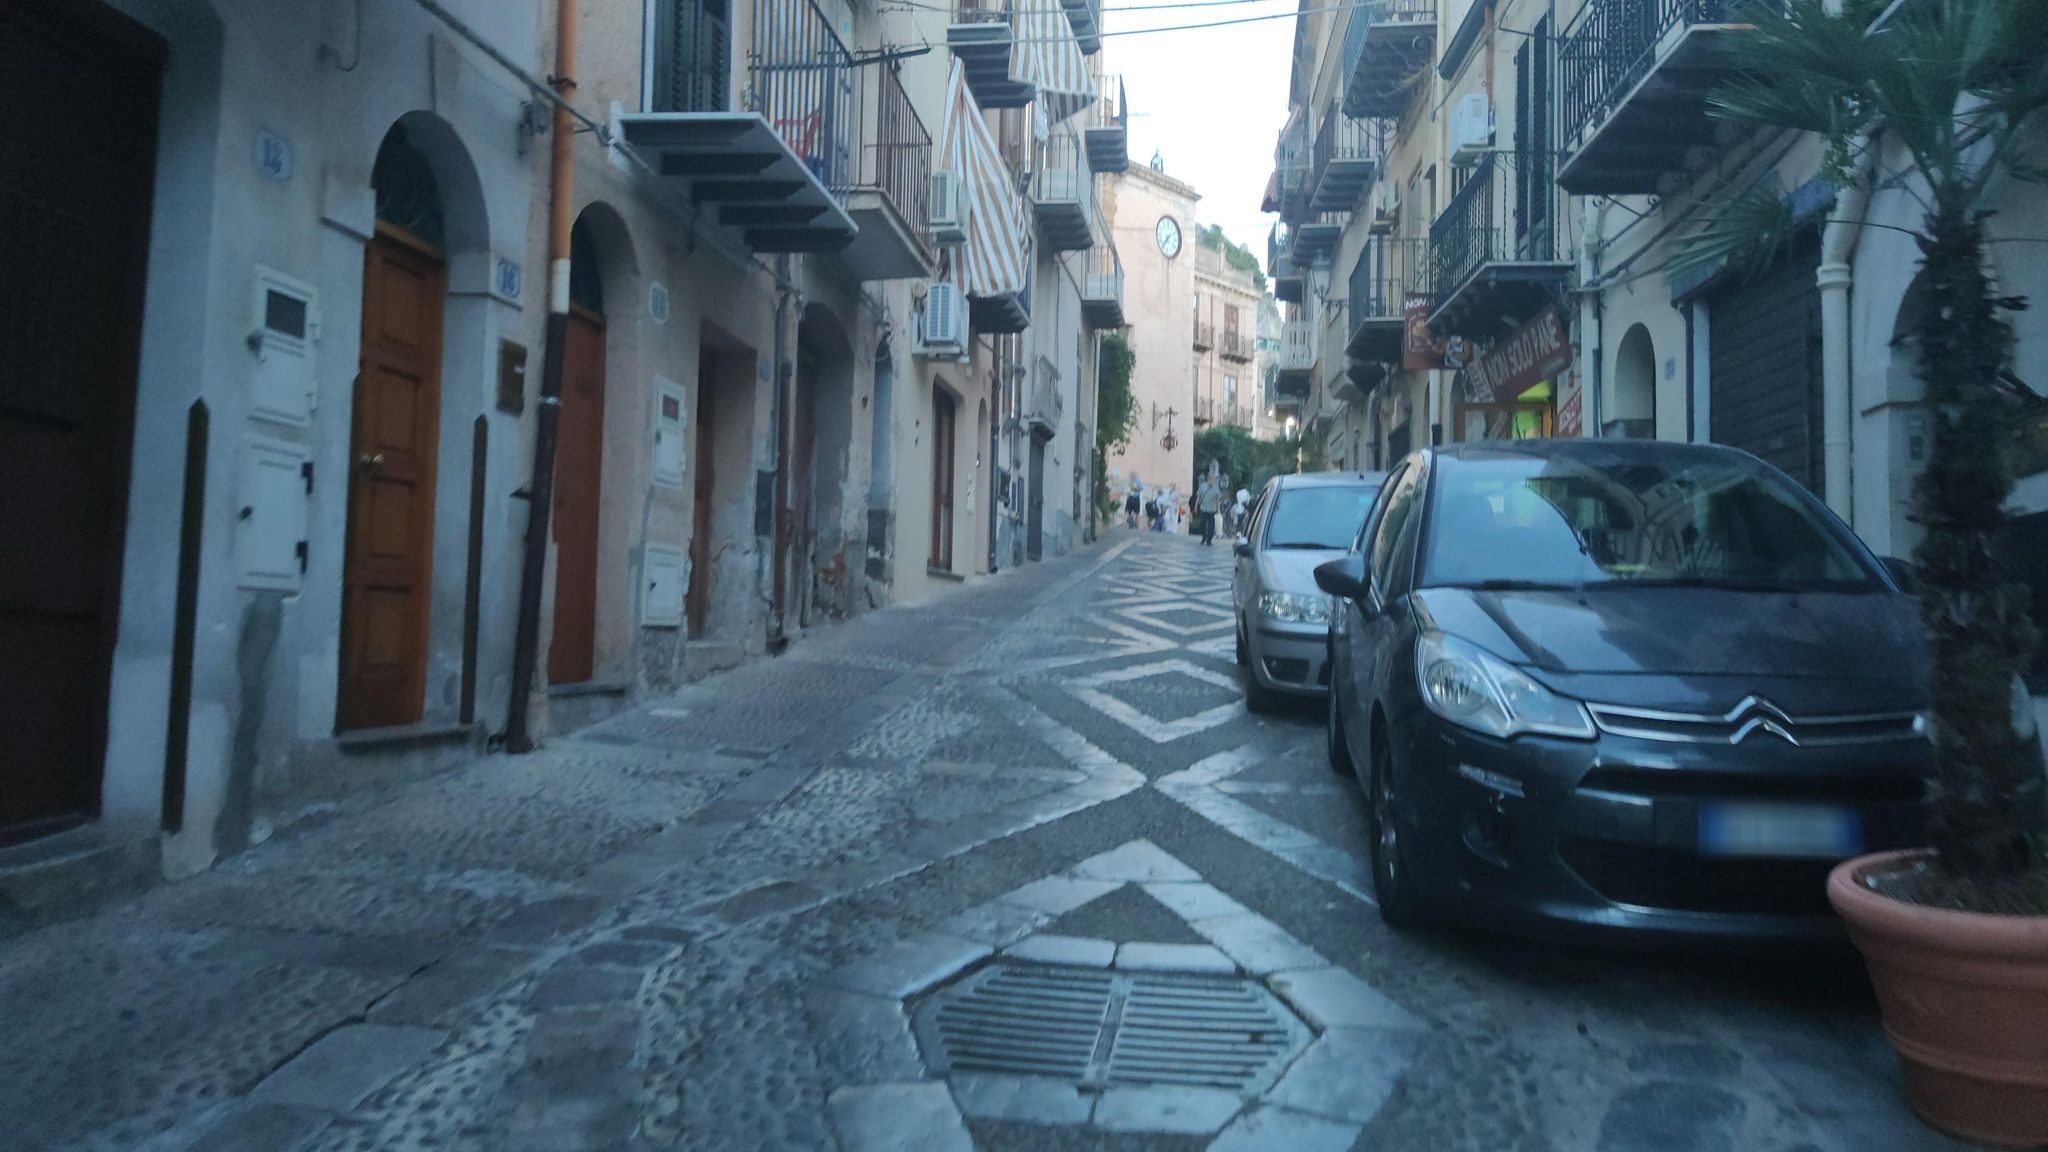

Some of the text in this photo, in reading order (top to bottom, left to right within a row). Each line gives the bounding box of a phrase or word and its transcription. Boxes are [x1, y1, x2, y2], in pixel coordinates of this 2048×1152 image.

[1485, 351, 1511, 391] NON
[1507, 331, 1534, 377] SOLO
[1530, 311, 1561, 361] PANE
